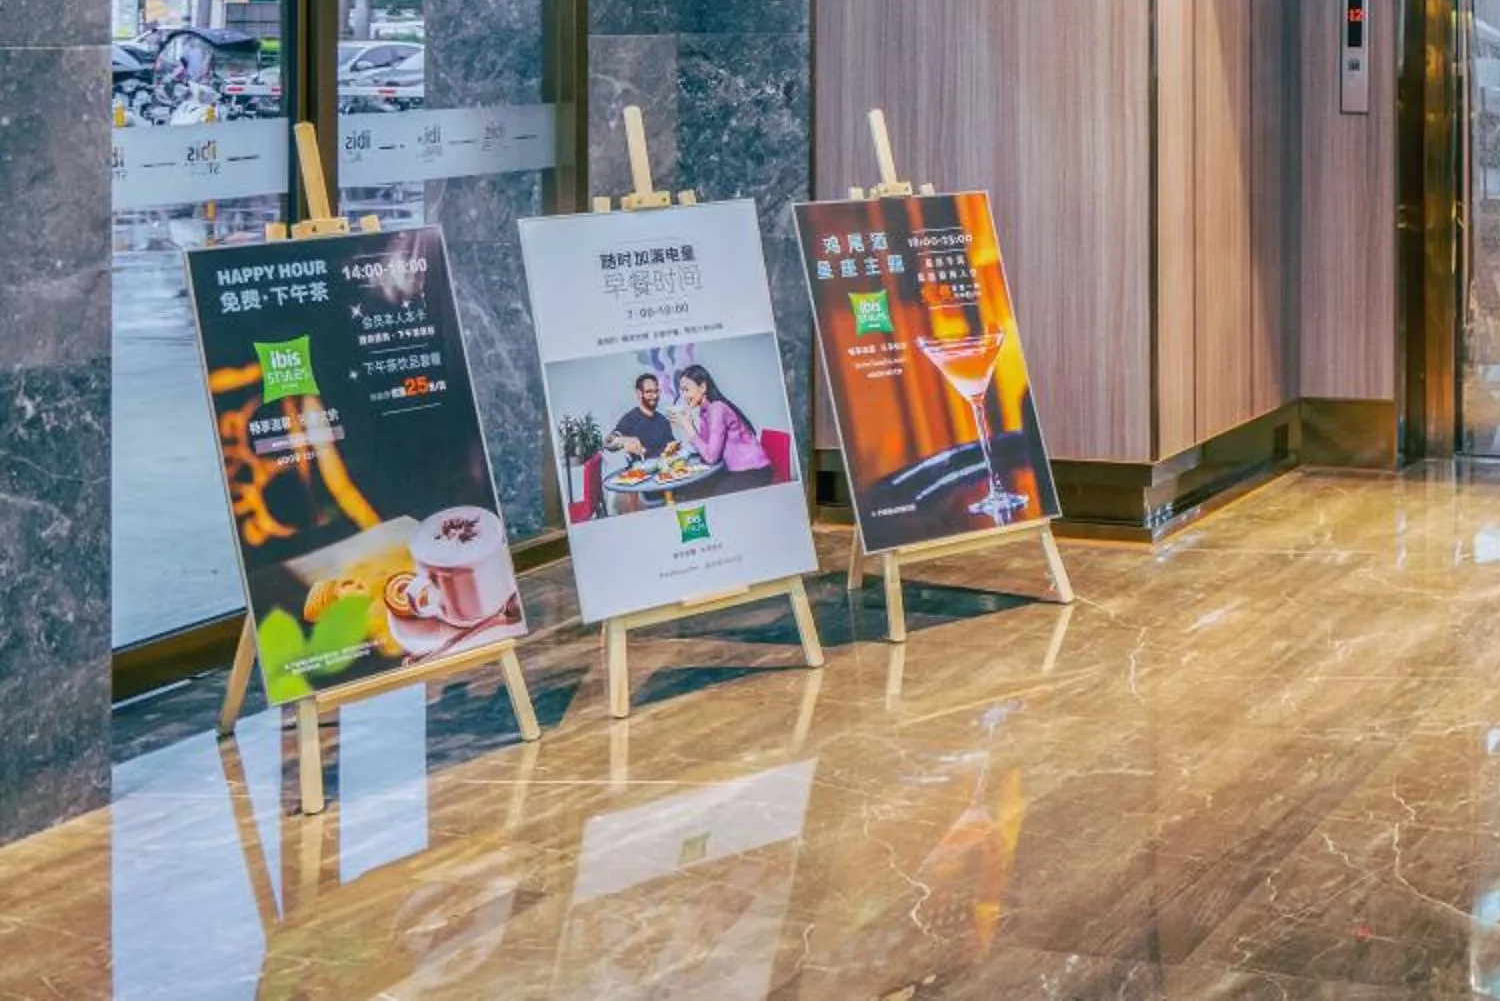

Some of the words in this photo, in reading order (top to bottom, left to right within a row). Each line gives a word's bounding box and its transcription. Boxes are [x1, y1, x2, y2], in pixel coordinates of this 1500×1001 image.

[217, 265, 275, 287] HAPPY
[277, 259, 328, 279] HOUR
[341, 258, 427, 281] 14:00-:00
[603, 264, 704, 301] 早餐时间
[269, 348, 301, 369] ibis
